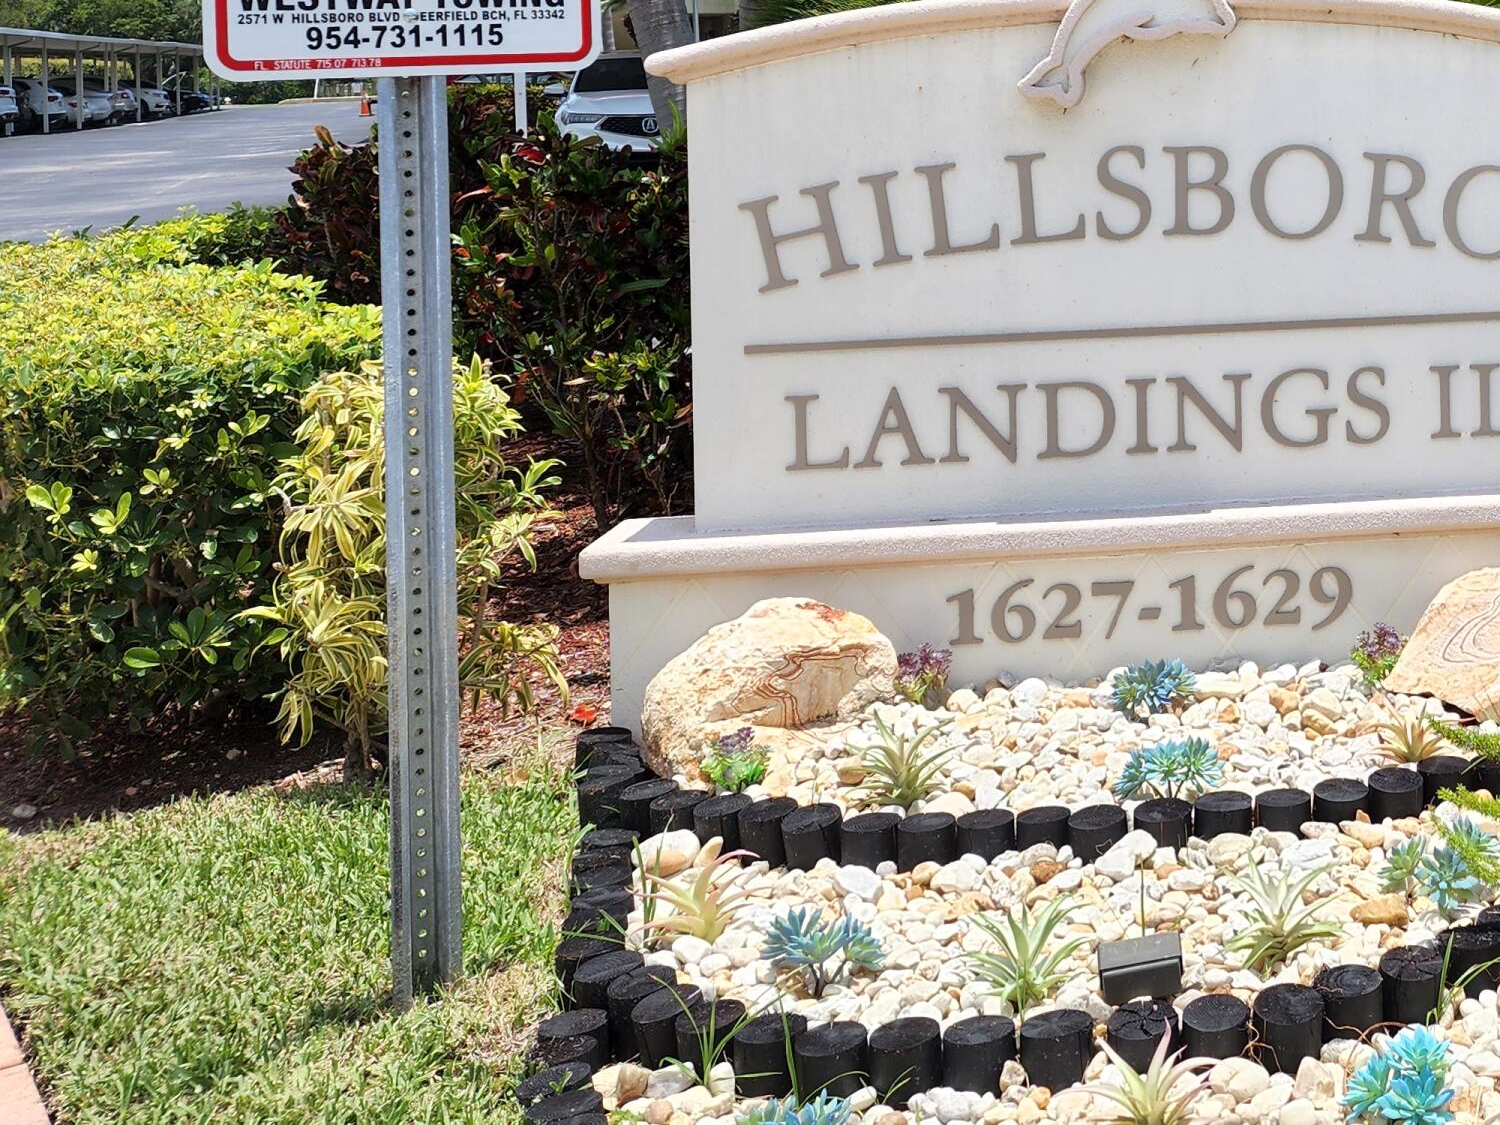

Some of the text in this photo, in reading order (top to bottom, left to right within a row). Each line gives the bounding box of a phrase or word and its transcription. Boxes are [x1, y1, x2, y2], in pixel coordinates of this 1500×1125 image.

[237, 9, 565, 25] 2571 W HILLSBORO BLVD EERFIELD BCH, FL 33342
[306, 25, 504, 51] 954-731-1115
[273, 59, 311, 70] STATUTE
[784, 365, 1392, 473] LANDINGS
[945, 562, 1353, 648] 1627-1629
